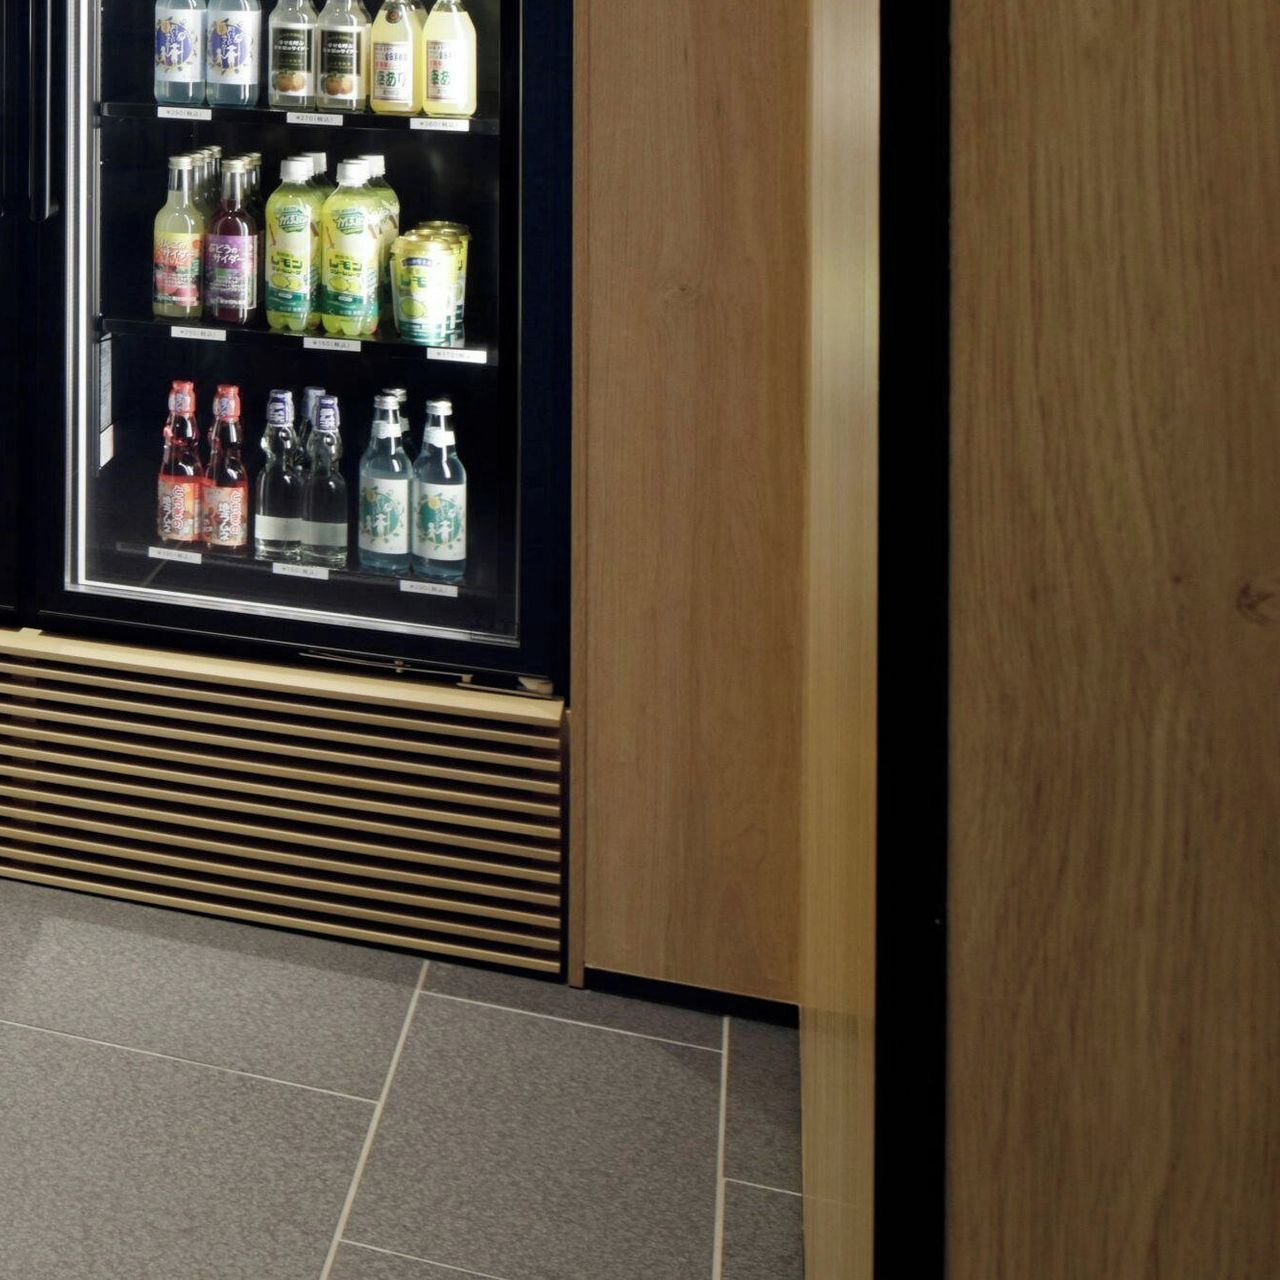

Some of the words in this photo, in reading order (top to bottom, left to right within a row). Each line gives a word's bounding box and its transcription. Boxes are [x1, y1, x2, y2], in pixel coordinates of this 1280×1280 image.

[271, 255, 303, 270] レモン
[329, 258, 363, 271] レモン
